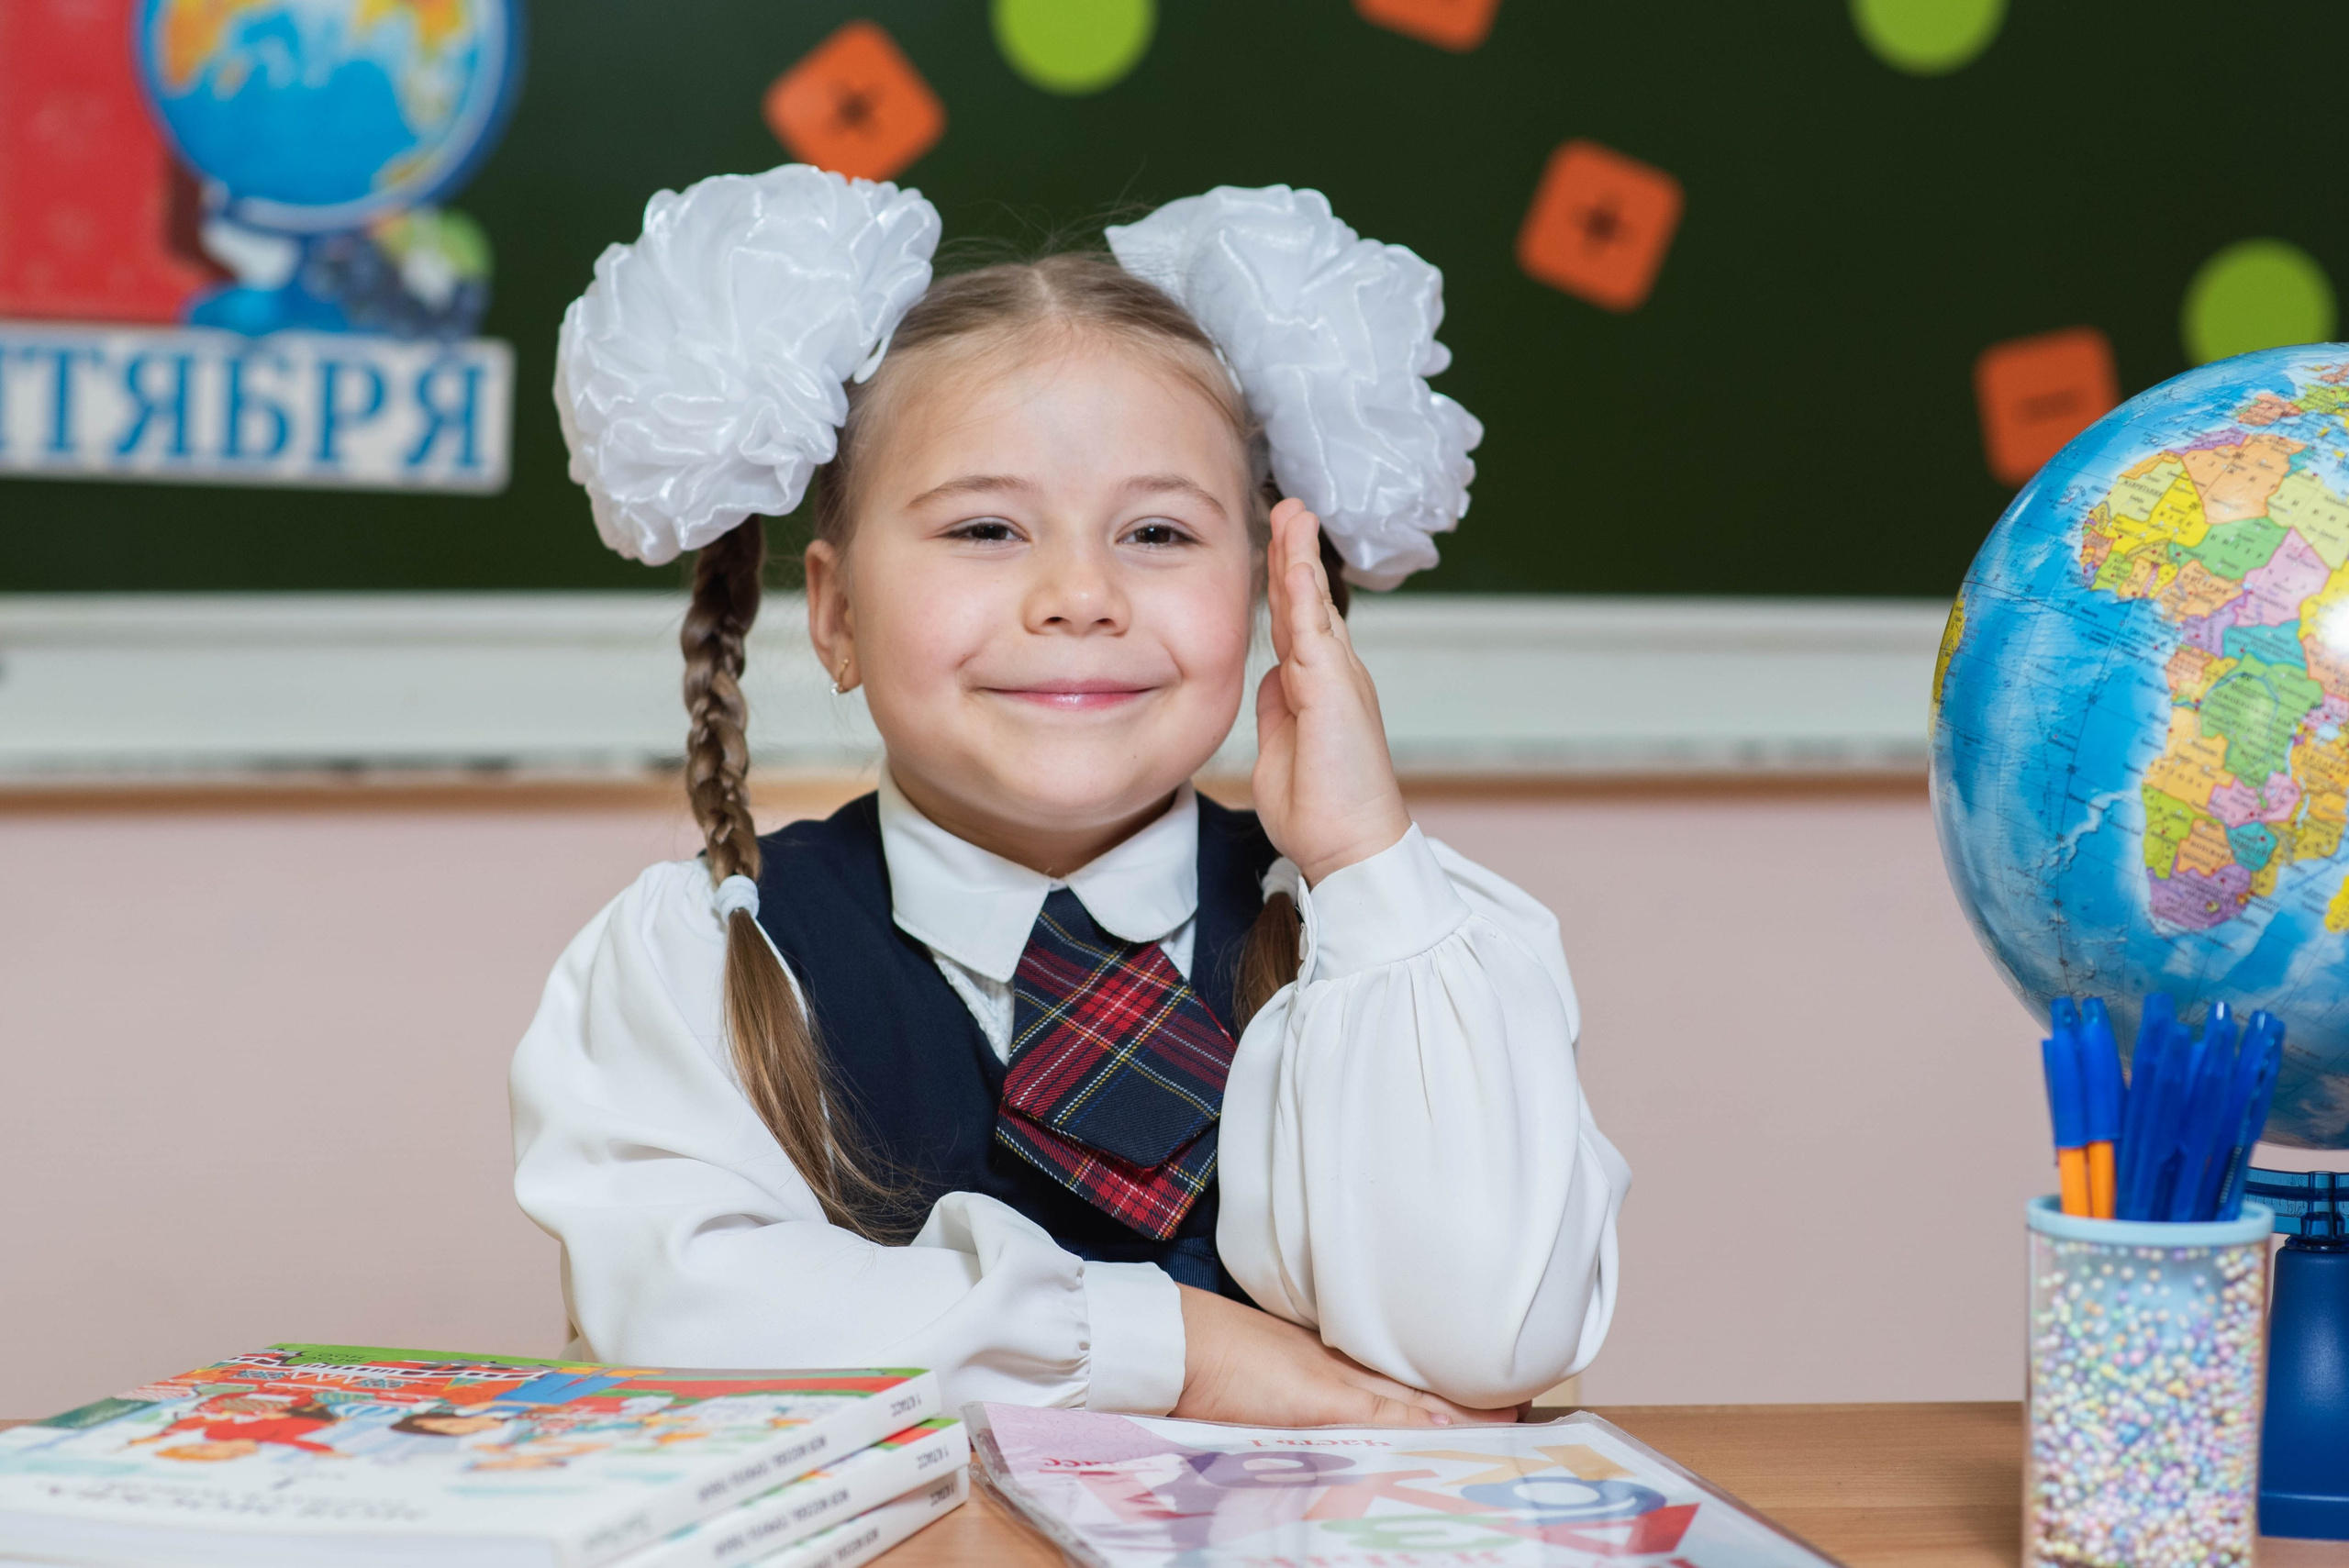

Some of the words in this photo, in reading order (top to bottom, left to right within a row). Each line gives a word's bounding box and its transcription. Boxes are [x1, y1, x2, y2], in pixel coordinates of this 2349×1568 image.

[0, 344, 487, 469] ТЯБРЯ
[1248, 1438, 1268, 1447] 1
[1275, 1438, 1392, 1447] Часть
